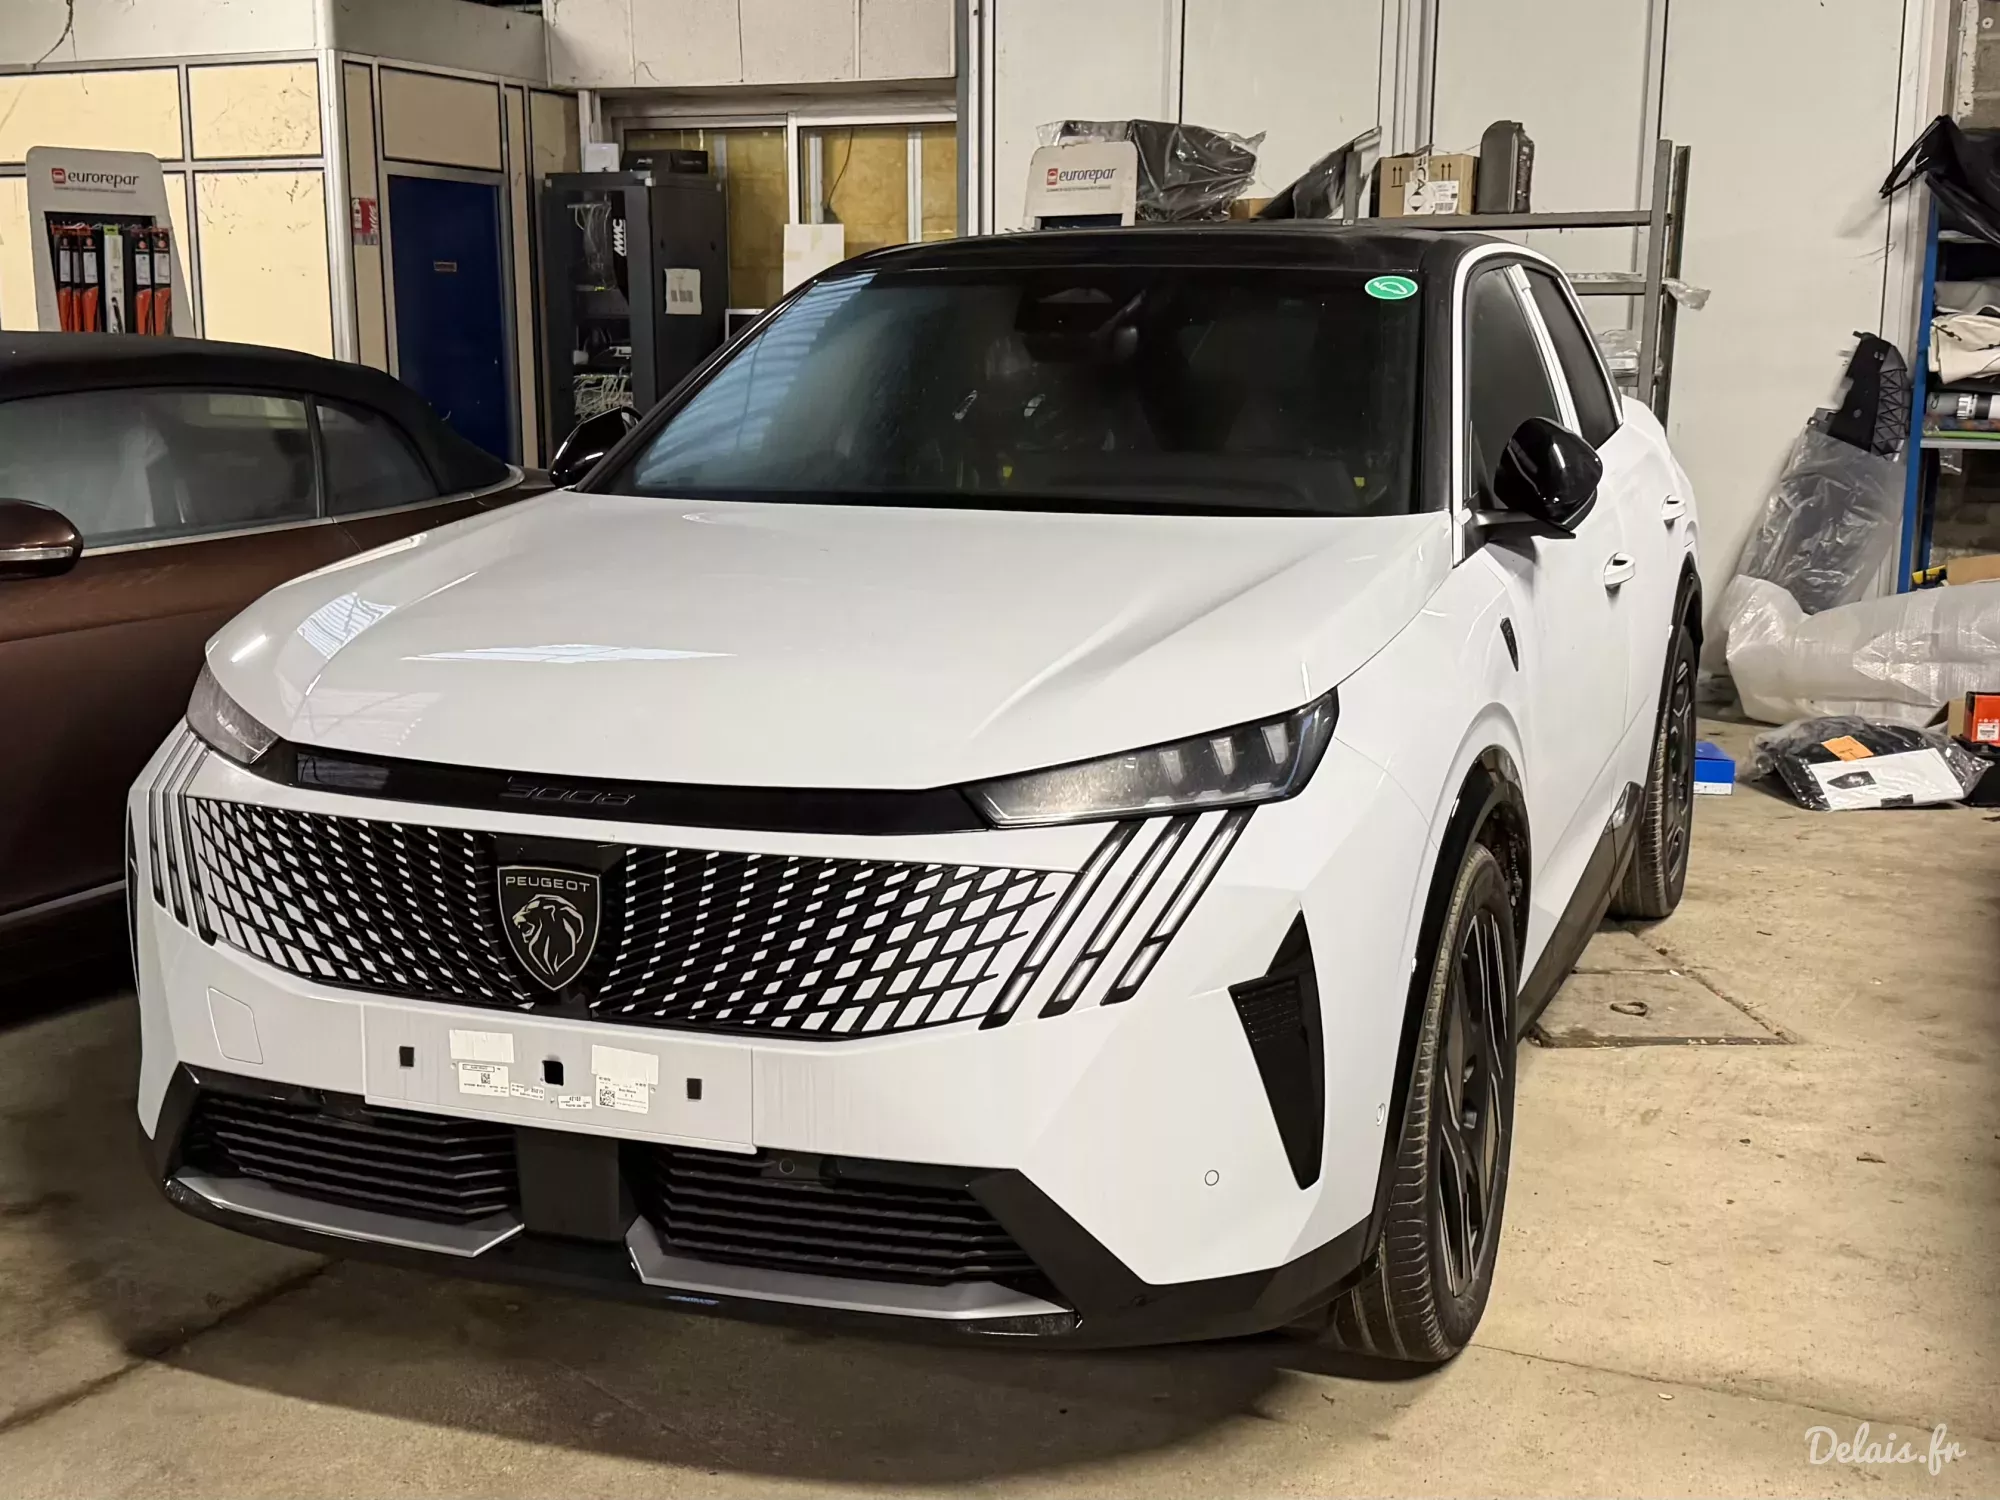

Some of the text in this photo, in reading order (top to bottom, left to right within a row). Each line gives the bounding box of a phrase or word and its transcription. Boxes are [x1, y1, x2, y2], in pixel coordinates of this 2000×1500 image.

[67, 171, 139, 188] eurorepar
[1058, 168, 1117, 184] eurorepar
[505, 876, 590, 893] PEUGEOT
